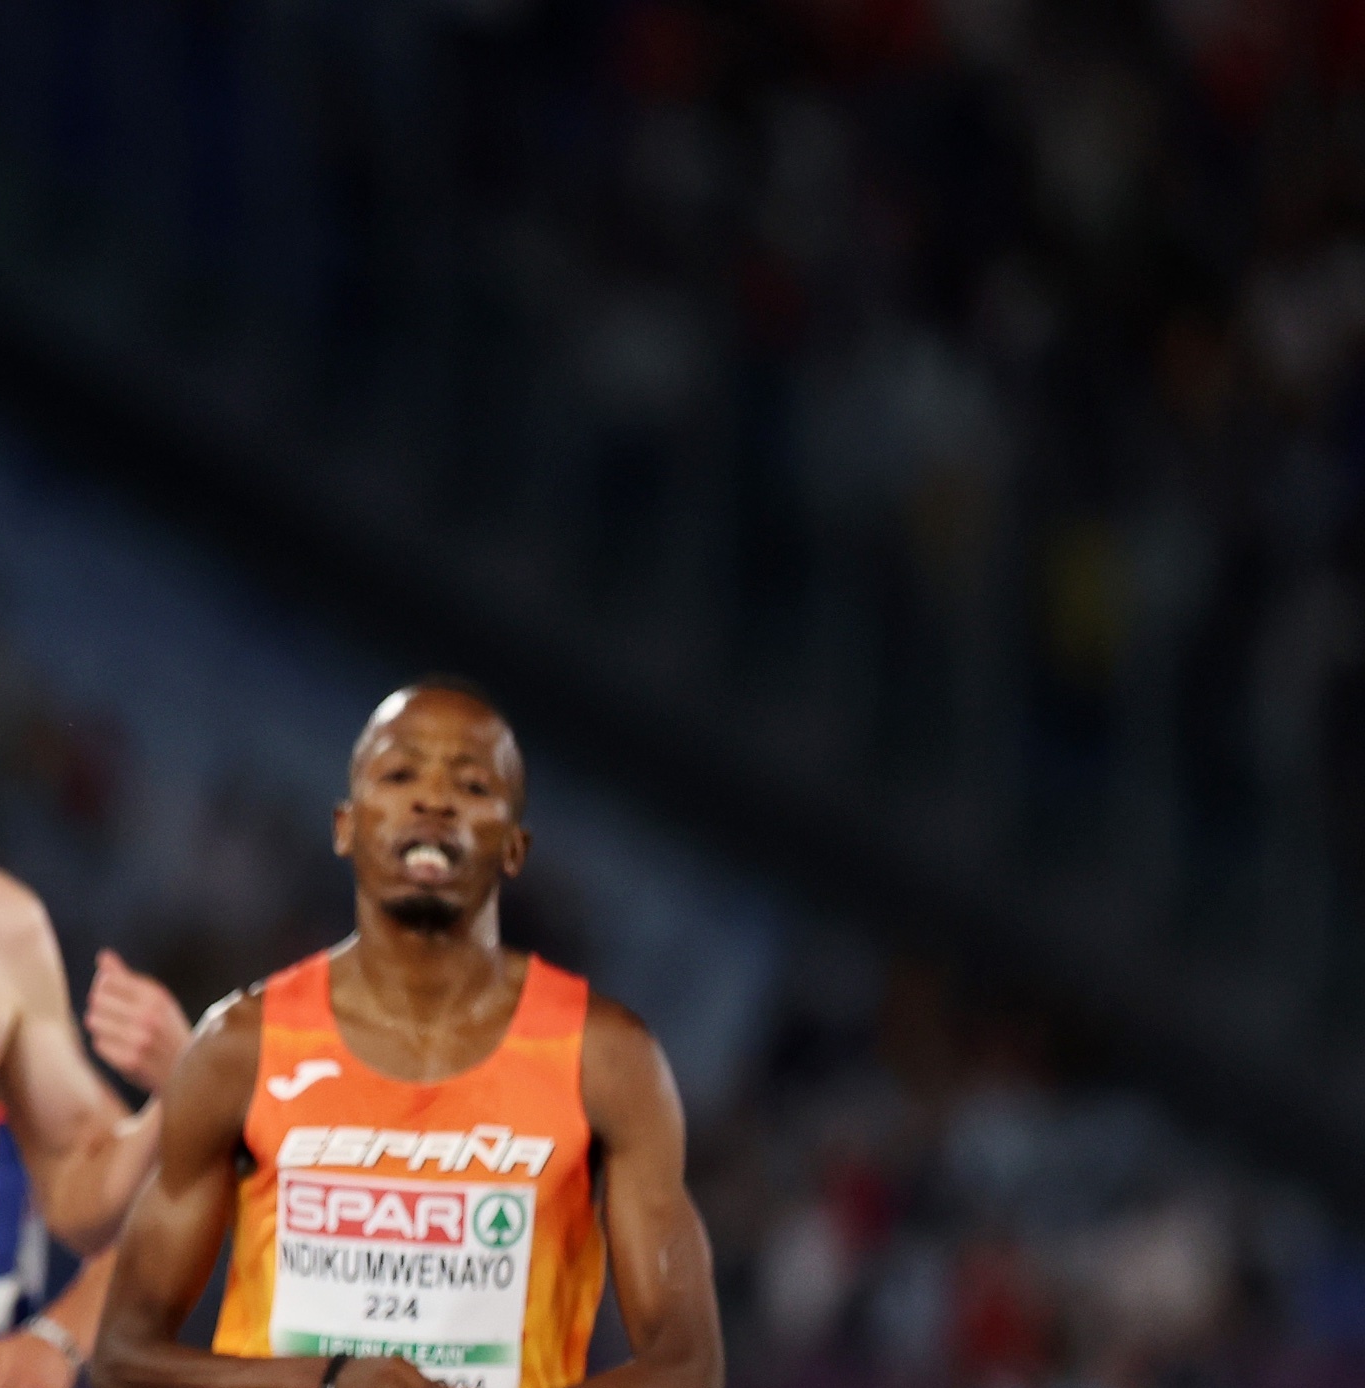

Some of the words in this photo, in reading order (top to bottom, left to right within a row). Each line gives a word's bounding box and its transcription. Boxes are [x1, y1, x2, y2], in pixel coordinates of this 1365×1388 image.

[275, 1123, 556, 1179] ESPAÑA
[285, 1184, 464, 1242] SPAR
[281, 1240, 515, 1291] NDIKUMWENAYO
[364, 1294, 419, 1320] 224
